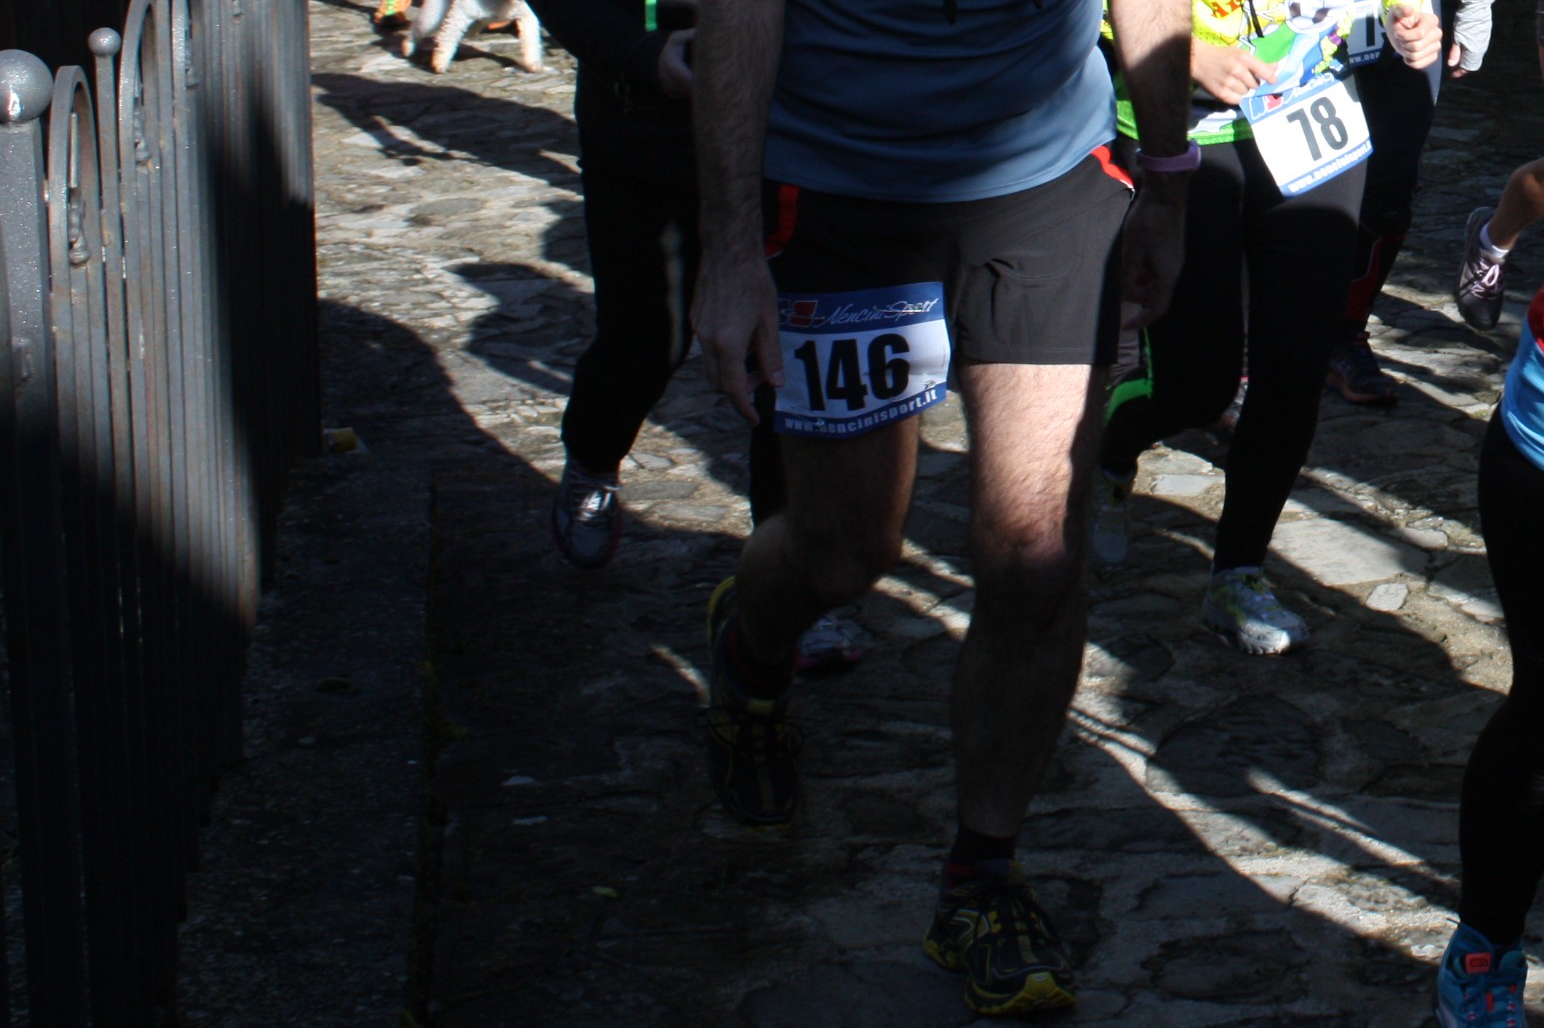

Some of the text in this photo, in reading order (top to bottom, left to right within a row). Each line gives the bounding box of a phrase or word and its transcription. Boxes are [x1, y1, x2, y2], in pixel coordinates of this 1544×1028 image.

[1286, 96, 1349, 162] 78
[814, 297, 940, 329] Nencini Sport
[794, 333, 910, 412] 146
[784, 387, 938, 434] www.nencinisport.it
